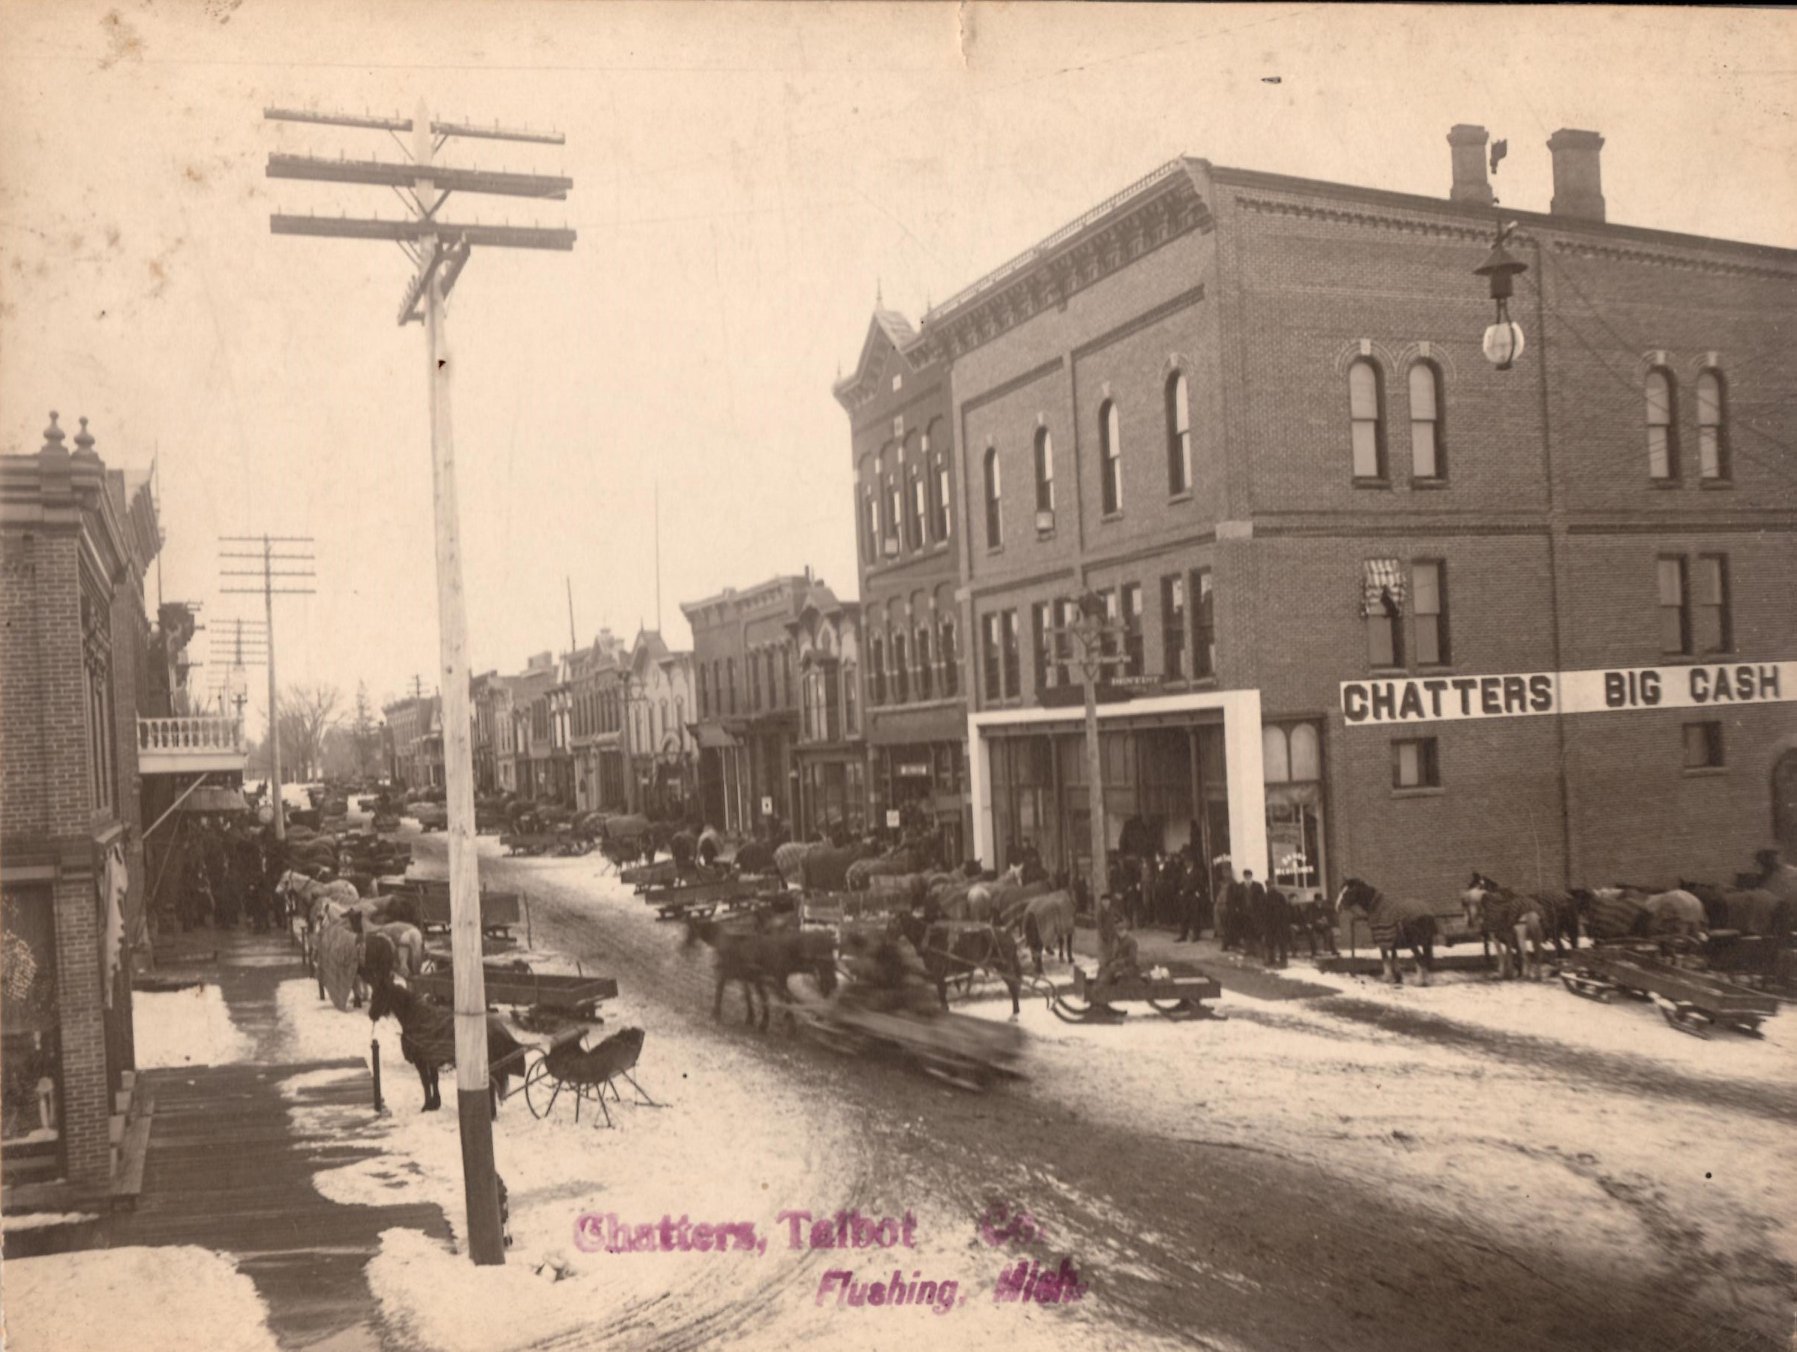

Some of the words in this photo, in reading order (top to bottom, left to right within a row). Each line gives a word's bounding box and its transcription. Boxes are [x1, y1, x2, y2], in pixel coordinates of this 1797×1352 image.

[1343, 675, 1553, 722] CHATTERS
[1604, 669, 1662, 708] BIG
[1689, 664, 1780, 701] CASH
